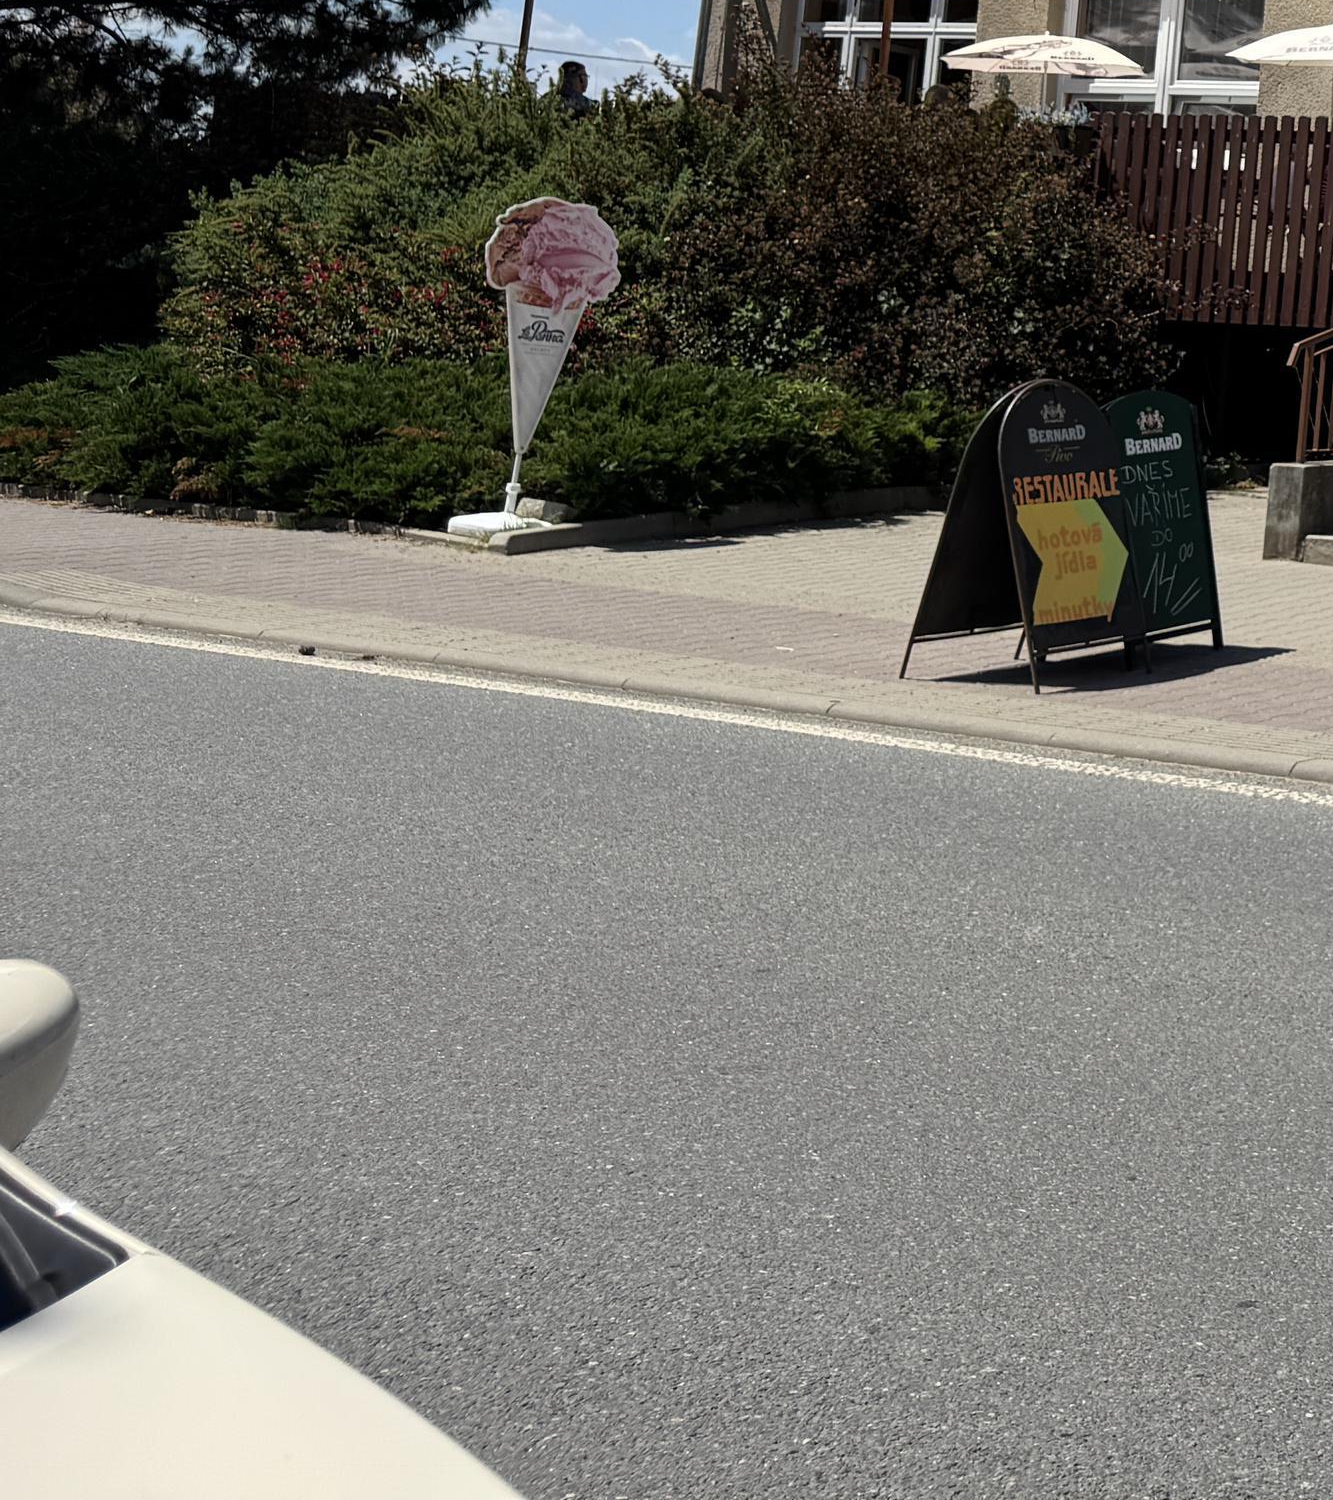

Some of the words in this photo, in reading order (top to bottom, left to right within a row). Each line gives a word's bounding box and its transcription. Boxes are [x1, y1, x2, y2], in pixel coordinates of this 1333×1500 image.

[1028, 424, 1086, 444] BERNARD
[1124, 433, 1183, 456] BERNARD
[1120, 460, 1174, 484] DNES
[1151, 528, 1173, 547] DO
[1055, 552, 1098, 580] jídla
